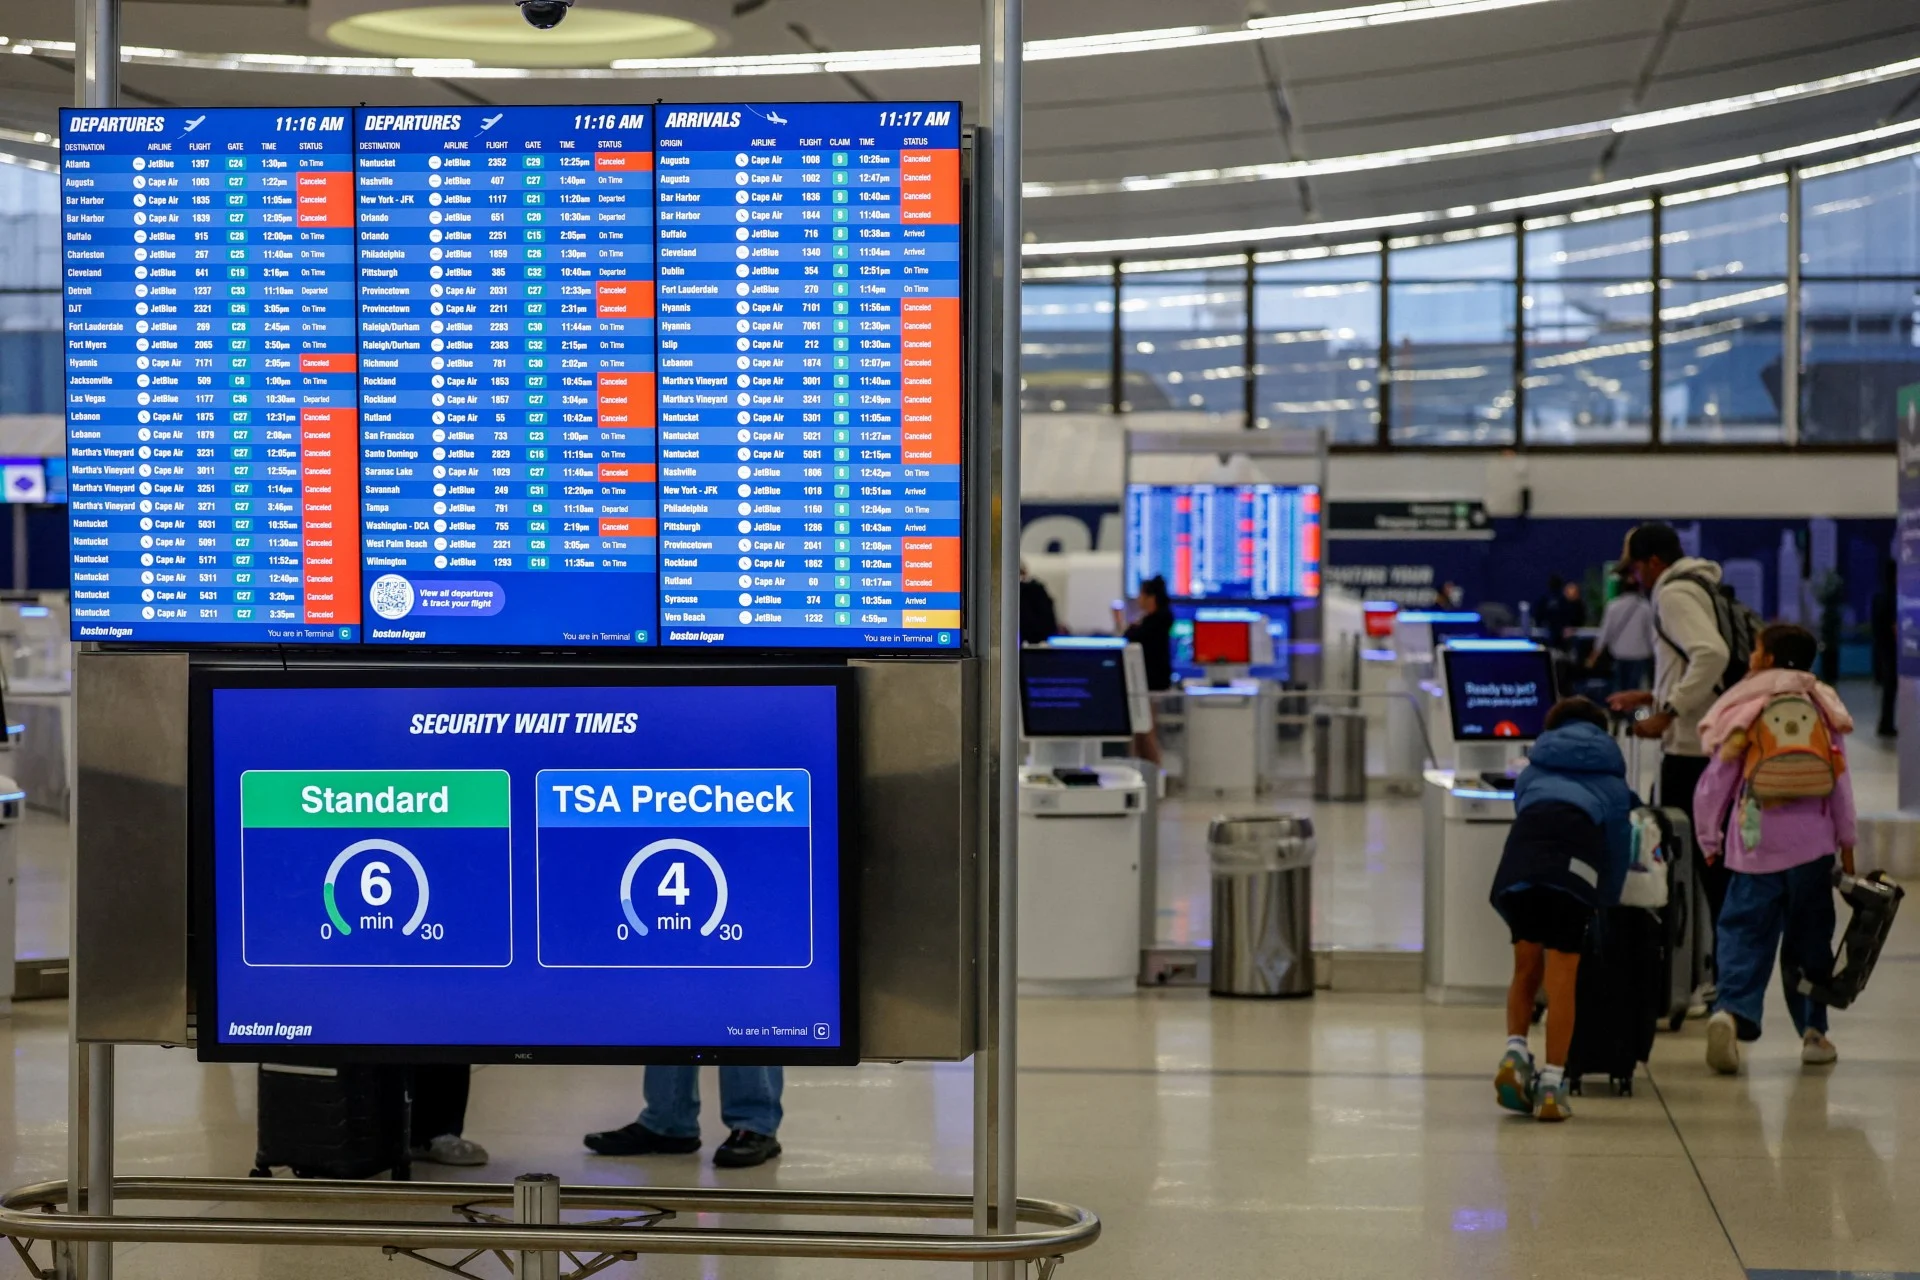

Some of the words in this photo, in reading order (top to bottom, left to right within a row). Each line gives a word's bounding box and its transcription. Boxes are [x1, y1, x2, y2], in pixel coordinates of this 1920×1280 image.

[70, 117, 164, 132] DEPARTURES
[277, 117, 316, 131] 11:16
[319, 117, 344, 130] AM
[365, 115, 461, 130] DEPARTURES
[575, 115, 615, 129] 11:16
[618, 115, 643, 128] AM
[665, 112, 741, 127] ARRIVALS
[881, 112, 922, 126] 11:17
[924, 112, 950, 125] AM
[66, 160, 90, 168] Atlanta
[148, 160, 174, 168] JetBlue
[262, 159, 287, 168] 1:30pm
[360, 159, 395, 167] Nantucket
[444, 158, 470, 166] JetBlue
[488, 158, 506, 166] 2352
[526, 158, 540, 166] C29
[560, 158, 589, 167] 12:25pm
[66, 179, 94, 188] Augusta
[149, 178, 166, 187] Cape
[168, 178, 178, 186] Air
[192, 178, 209, 186] 1003
[229, 178, 243, 186] C27
[262, 178, 287, 186] 1:22pm
[661, 175, 690, 184] Augusta
[752, 174, 770, 184] Cape
[772, 174, 782, 182] Air
[802, 174, 820, 182] 1002
[838, 174, 843, 182] 9
[860, 174, 890, 183] 12:47pm
[400, 195, 414, 203] JFK
[444, 195, 471, 203] JetBlue
[489, 195, 506, 203] 1117
[527, 195, 540, 203] C21
[599, 195, 625, 203] Departed
[361, 232, 389, 240] Orlando
[489, 231, 506, 239] 2251
[527, 231, 541, 239] C15
[561, 231, 586, 240] 2:05pm
[662, 267, 684, 275] Dublin
[752, 267, 779, 275] JetBlue
[805, 266, 818, 274] 354
[860, 266, 890, 276] 12:51pm
[696, 377, 727, 386] Vineyard
[753, 377, 771, 386] Cape
[773, 377, 784, 385] Air
[803, 377, 820, 385] 3001
[839, 377, 844, 385] 9
[861, 377, 890, 385] 11:40am
[74, 555, 108, 563] Nantucket
[156, 556, 174, 565] Cape
[199, 556, 216, 564] 5171
[236, 556, 250, 564] C27
[269, 556, 298, 564] 11:52am
[451, 590, 493, 598] departures
[471, 600, 491, 609] flight
[1465, 682, 1500, 696] Ready
[1503, 683, 1514, 694] to
[410, 714, 510, 734] SECURITY
[515, 713, 570, 733] WAIT
[575, 713, 638, 733] TIMES
[302, 786, 448, 813] Standard
[553, 785, 621, 813] TSA
[633, 785, 794, 812] PreCheck
[361, 862, 391, 906] 6
[658, 863, 689, 905] 4
[361, 912, 393, 929] min
[658, 913, 691, 929] min
[321, 924, 331, 939] 0
[421, 924, 443, 940] 30
[617, 924, 628, 940] 0
[720, 924, 742, 940] 30
[727, 1027, 743, 1035] You
[762, 1027, 769, 1035] in
[772, 1027, 807, 1035] Terminal
[818, 1027, 825, 1035] C
